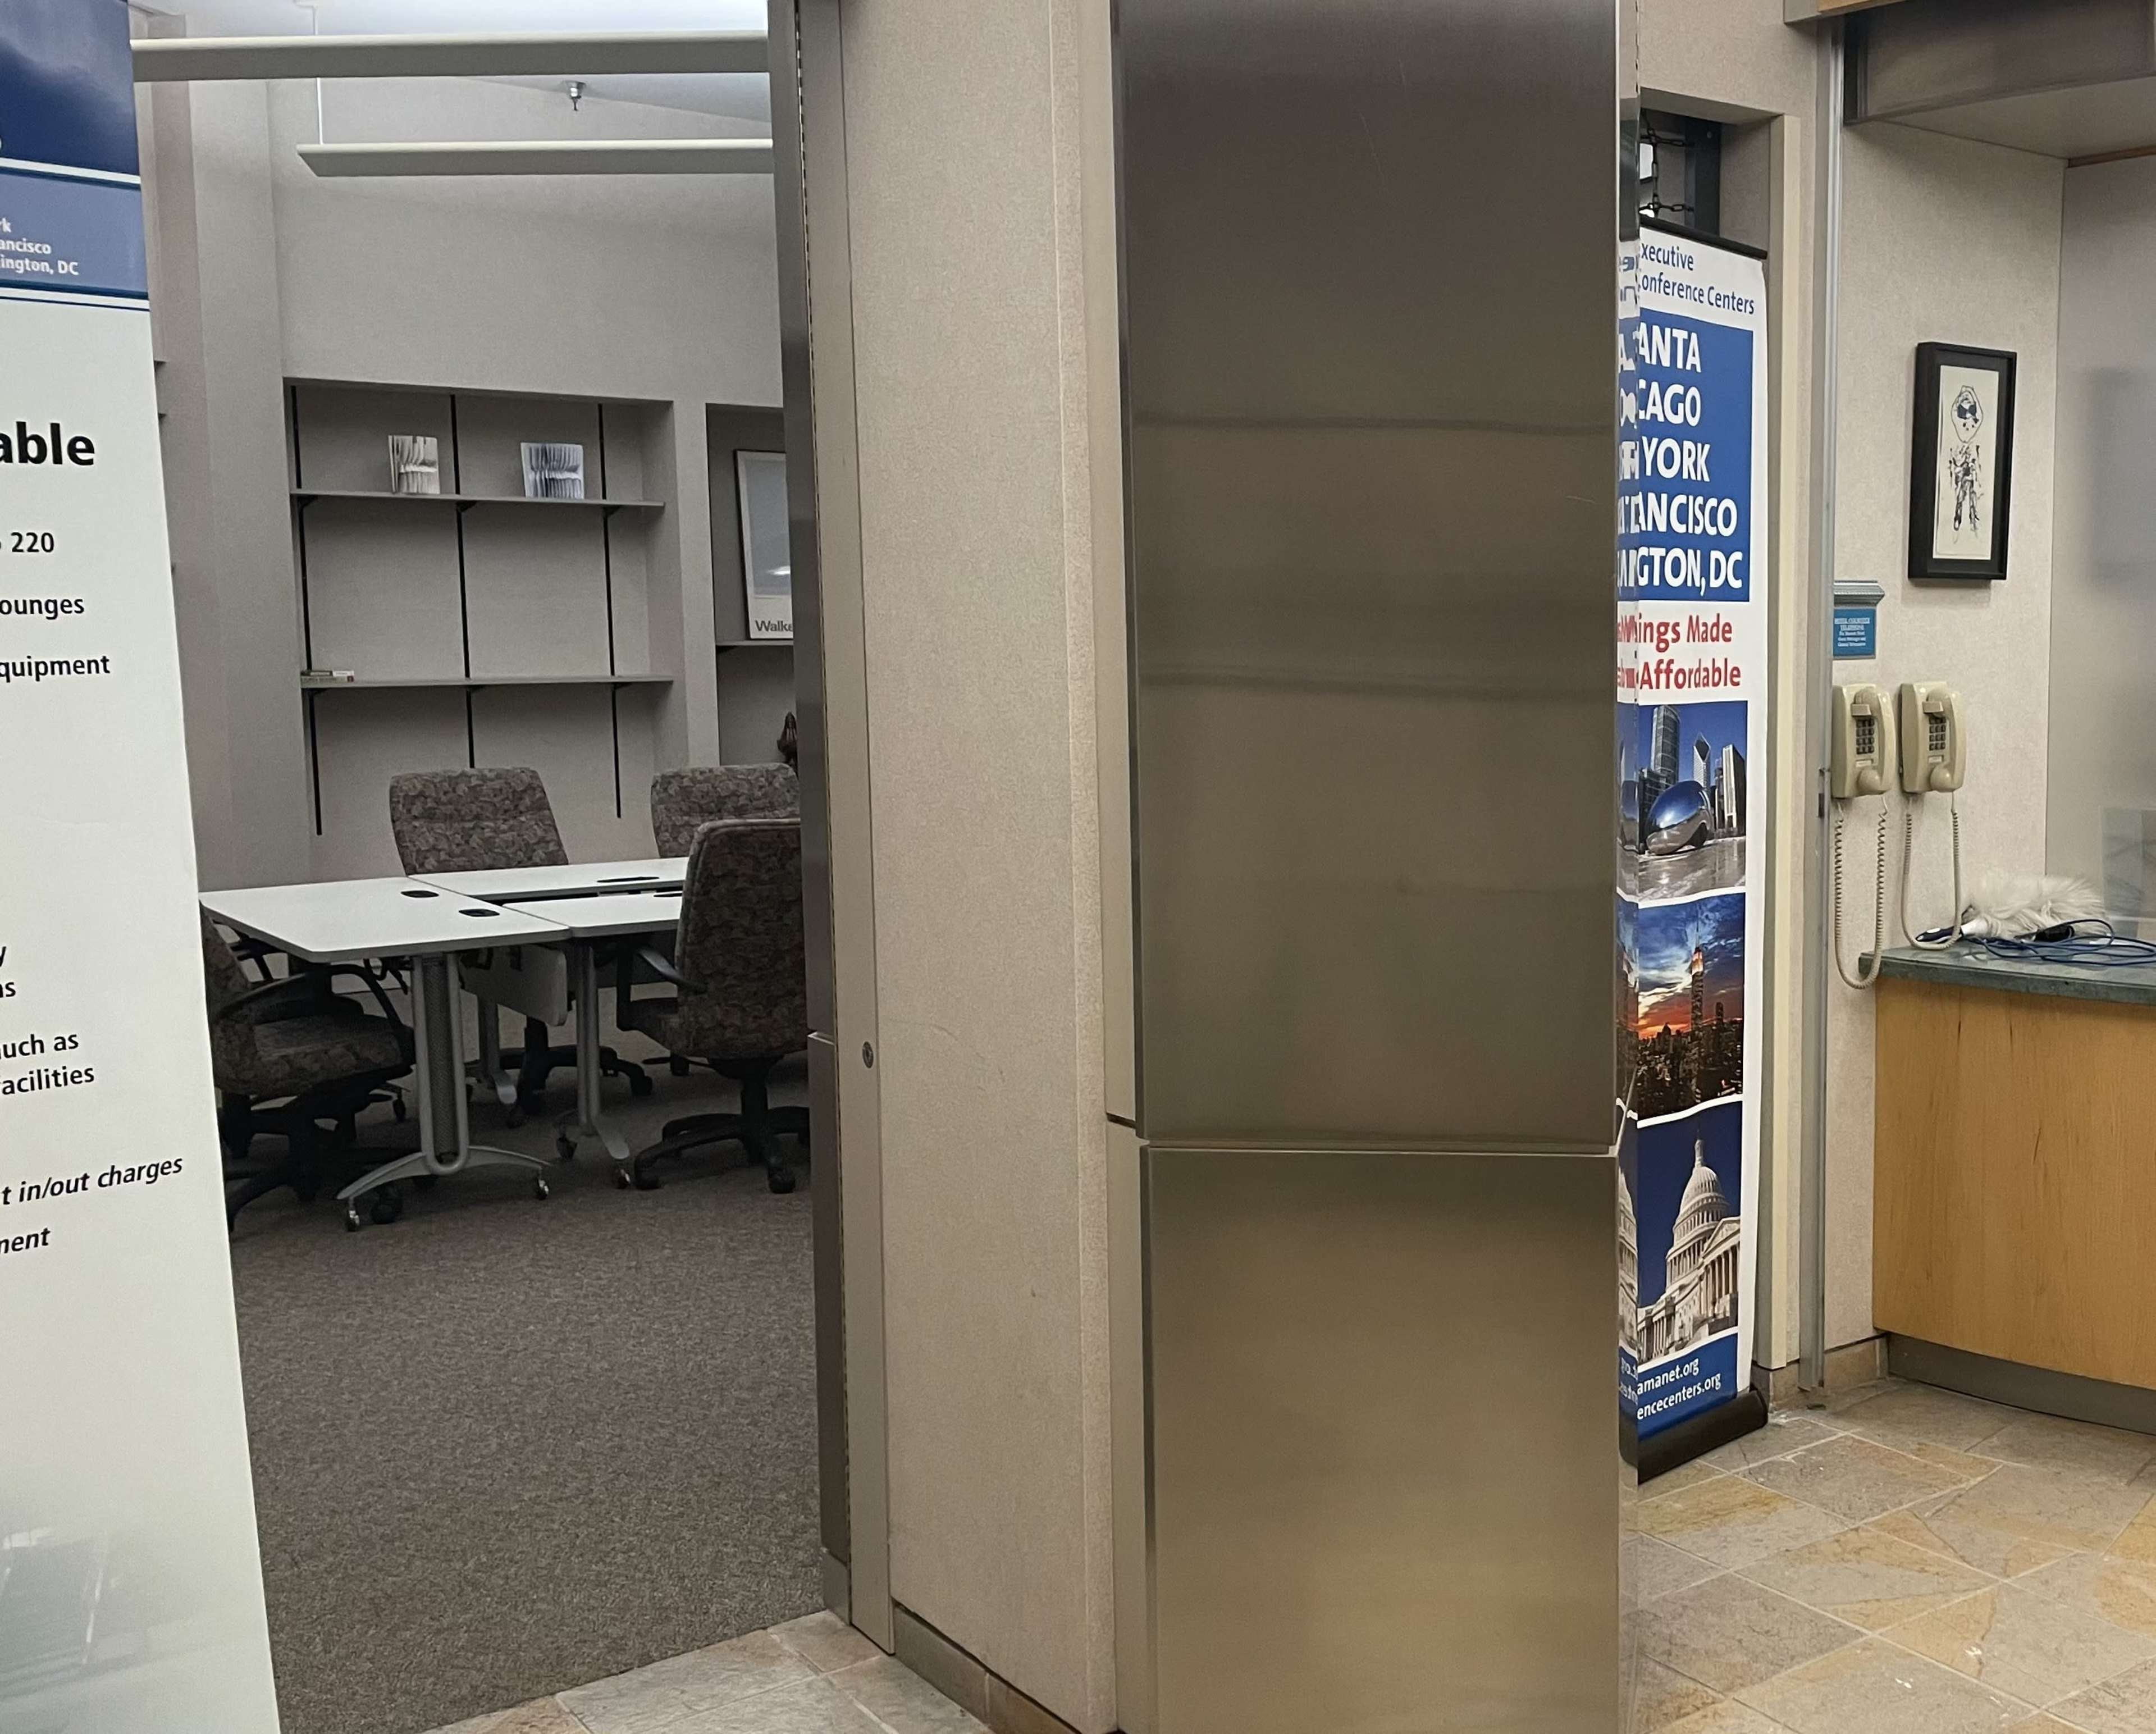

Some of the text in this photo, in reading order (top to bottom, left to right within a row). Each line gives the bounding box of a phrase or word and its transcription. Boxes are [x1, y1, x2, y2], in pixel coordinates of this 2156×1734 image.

[57, 260, 79, 275] DC
[1707, 286, 1755, 314] Centers
[1642, 436, 1710, 482] YORK
[11, 532, 54, 553] 220
[1686, 613, 1733, 643] Made
[1639, 658, 1741, 690] Affordable
[0, 1034, 79, 1060] uch as
[0, 1066, 94, 1095] acilities
[19, 1172, 90, 1202] in/out
[98, 1158, 182, 1188] charges
